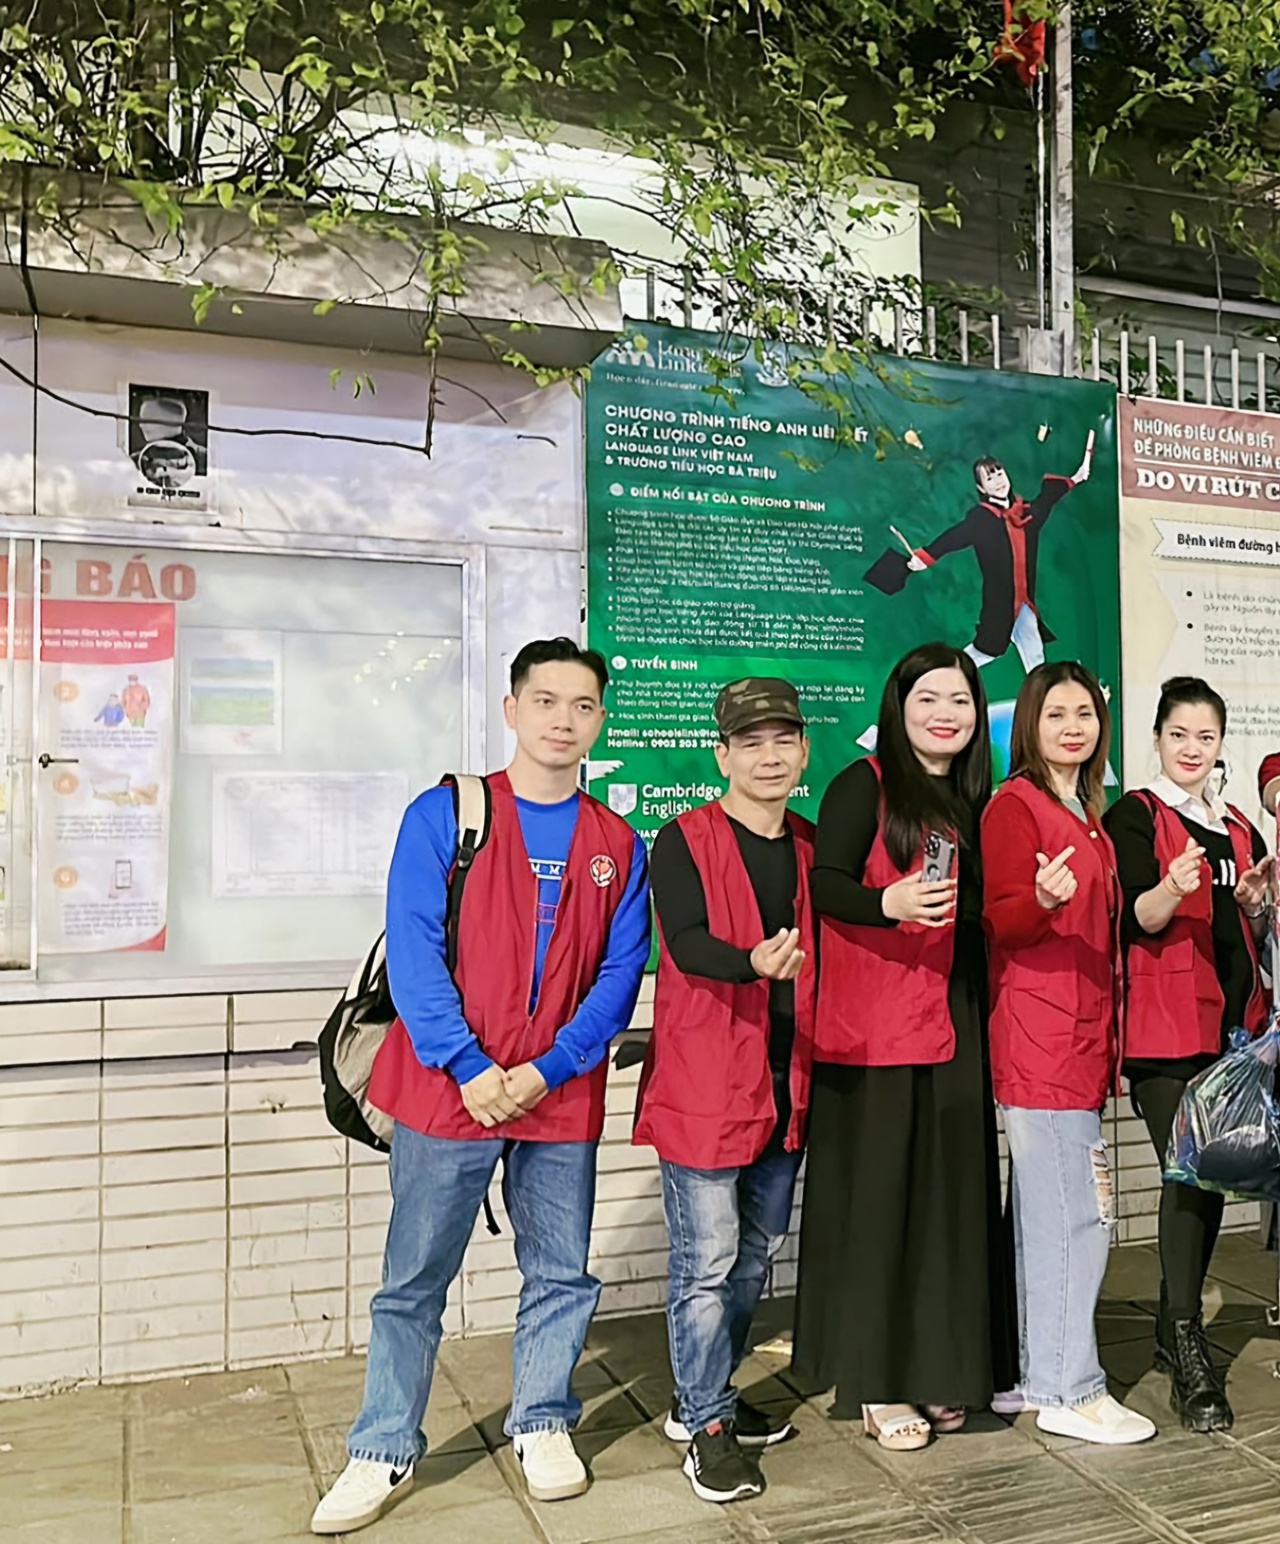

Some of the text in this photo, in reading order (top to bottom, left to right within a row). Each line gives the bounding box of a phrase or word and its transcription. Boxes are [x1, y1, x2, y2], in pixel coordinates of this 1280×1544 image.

[605, 421, 746, 447] CHẤT LƯỢNG CAO
[681, 411, 724, 428] TRÌNH
[729, 414, 771, 432] TIẾNG
[776, 422, 807, 436] ANH
[1134, 417, 1182, 439] NHỮNG
[1247, 431, 1274, 449] BIẾT
[605, 440, 669, 455] LANGUAGE
[672, 446, 698, 458] LINK
[727, 451, 753, 463] NAM
[1154, 442, 1200, 461] PHÒNG
[1204, 446, 1239, 466] BỆNH
[1240, 451, 1273, 468] VIÊM
[1136, 467, 1175, 490] DO
[1178, 473, 1208, 494] VI
[1210, 475, 1262, 499] RÚT
[1177, 533, 1206, 548] Bệnh
[1238, 538, 1273, 555] đường
[76, 553, 196, 601] BÁO
[607, 738, 648, 748] Hotline:
[642, 783, 722, 800] Cambridge
[642, 801, 692, 819] English
